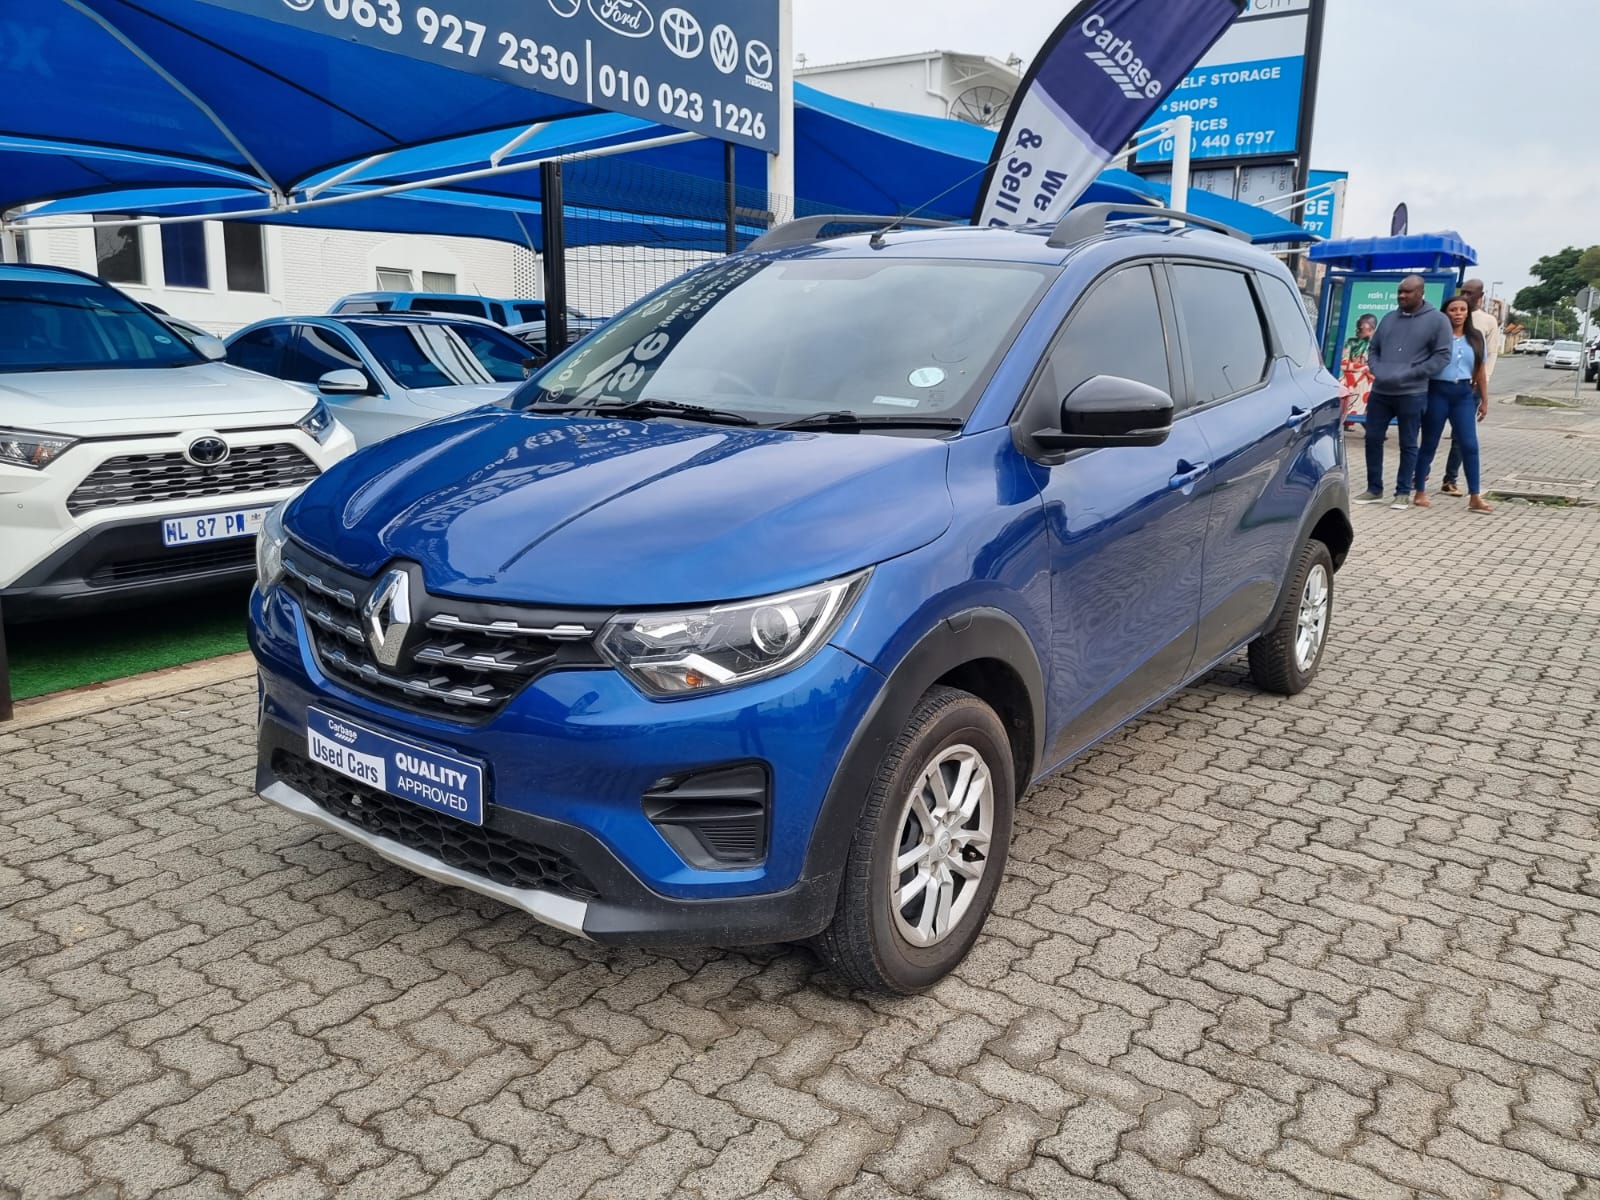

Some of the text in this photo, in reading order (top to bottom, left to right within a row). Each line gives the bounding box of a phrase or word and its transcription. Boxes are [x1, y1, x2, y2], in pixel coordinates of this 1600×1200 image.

[601, 0, 643, 29] Ford
[416, 6, 486, 57] 927
[498, 31, 578, 86] 2330
[1081, 14, 1162, 98] Carbase
[1210, 67, 1281, 86] STORAGE
[599, 65, 766, 140] 010 023 1226
[1170, 97, 1218, 112] SHOPS
[1015, 128, 1042, 149] &
[1159, 130, 1275, 154] (0) 440 6797
[995, 157, 1032, 214] Sell
[1033, 169, 1068, 212] We
[196, 517, 216, 538] 87
[328, 719, 358, 739] Carbase
[312, 736, 379, 784] Used Cars
[395, 752, 468, 791] QUALITY
[397, 775, 468, 812] APPROVED
